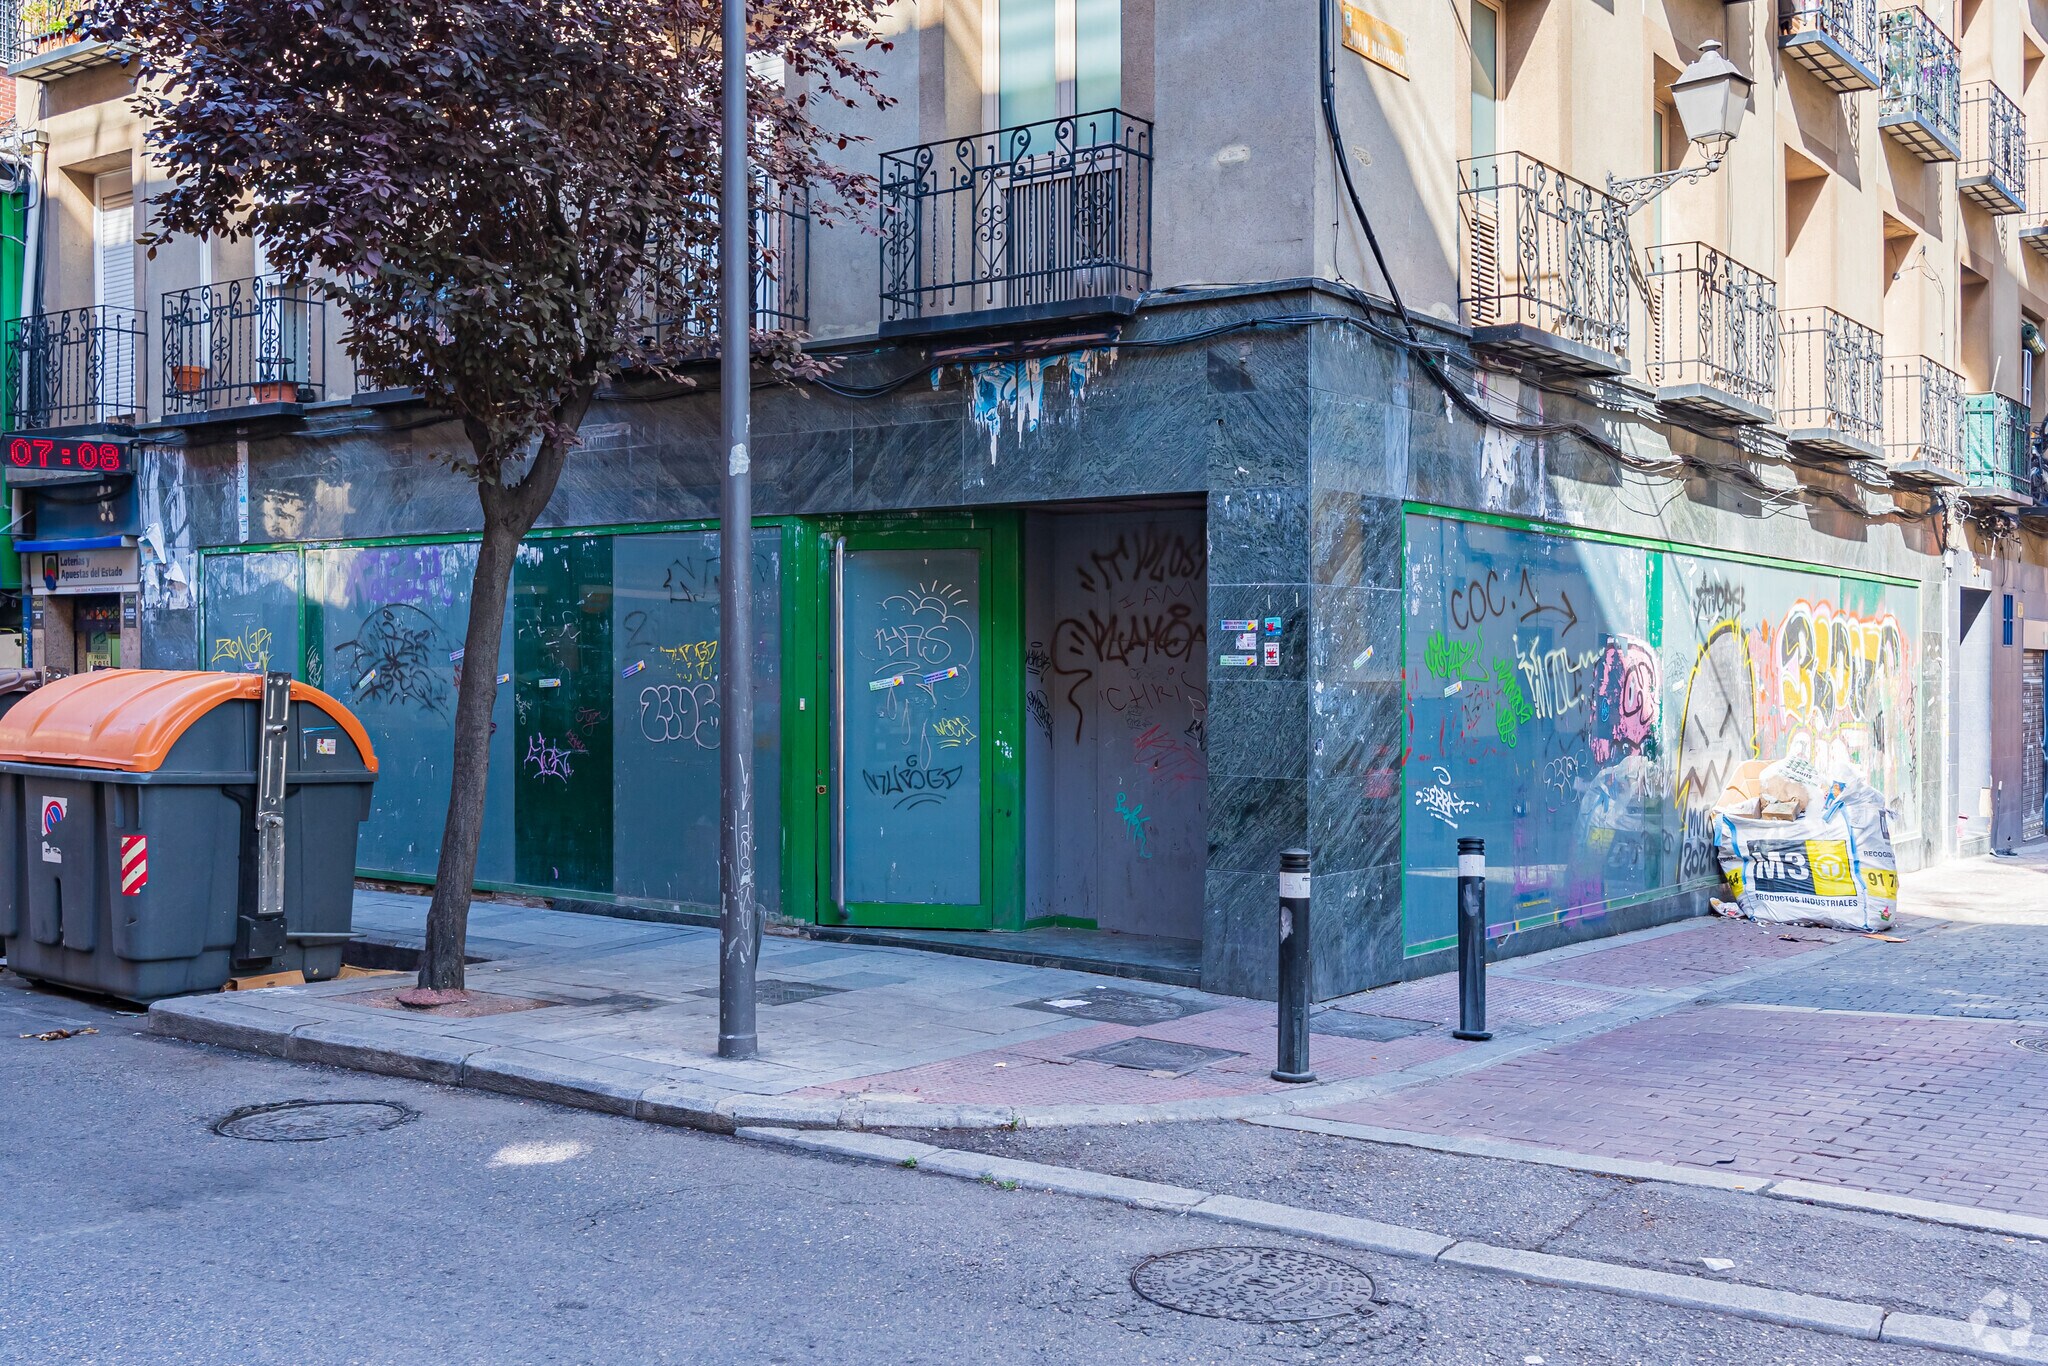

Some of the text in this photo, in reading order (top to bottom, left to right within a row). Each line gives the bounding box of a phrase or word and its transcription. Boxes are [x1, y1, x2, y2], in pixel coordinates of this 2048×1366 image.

[10, 438, 119, 471] 07:08
[85, 557, 90, 567] y
[61, 566, 123, 581] Apuestas del Estado
[1752, 851, 1810, 880] M3
[1868, 872, 1885, 887] 91
[1755, 893, 1858, 907] PRODUCTOS INDUSTRIALES
